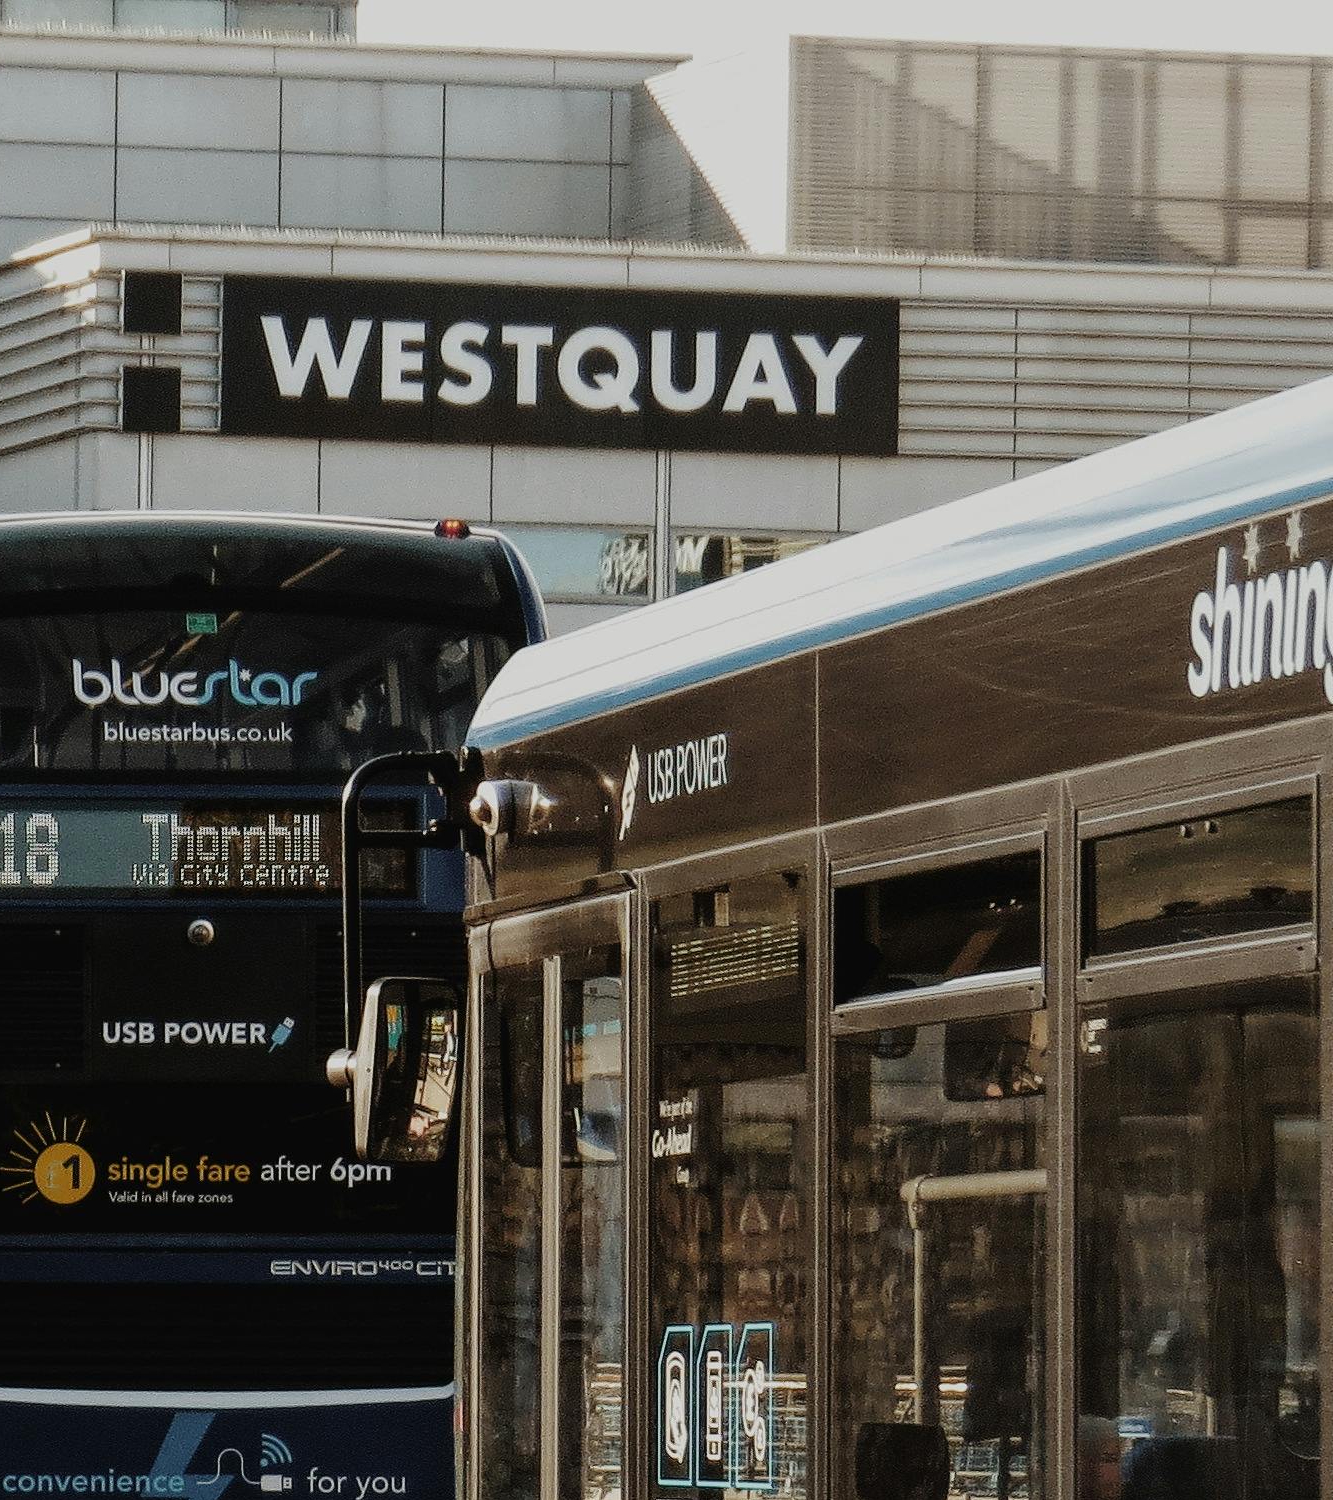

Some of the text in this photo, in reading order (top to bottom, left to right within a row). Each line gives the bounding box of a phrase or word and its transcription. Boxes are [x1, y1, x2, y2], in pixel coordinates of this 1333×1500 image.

[259, 314, 864, 416] WESTQUAY
[72, 657, 319, 706] bluestar
[103, 722, 293, 743] bluestarbus.co.uk
[647, 732, 728, 804] USB POWER
[142, 813, 321, 861] Thornhill
[102, 1021, 267, 1045] USB POWER
[107, 1156, 190, 1188] single
[197, 1156, 251, 1184] fare
[260, 1156, 322, 1183] after
[329, 1156, 393, 1188] 6pm
[108, 1191, 234, 1204] Valid in all fare zones
[2, 1467, 407, 1500] convenience for you
